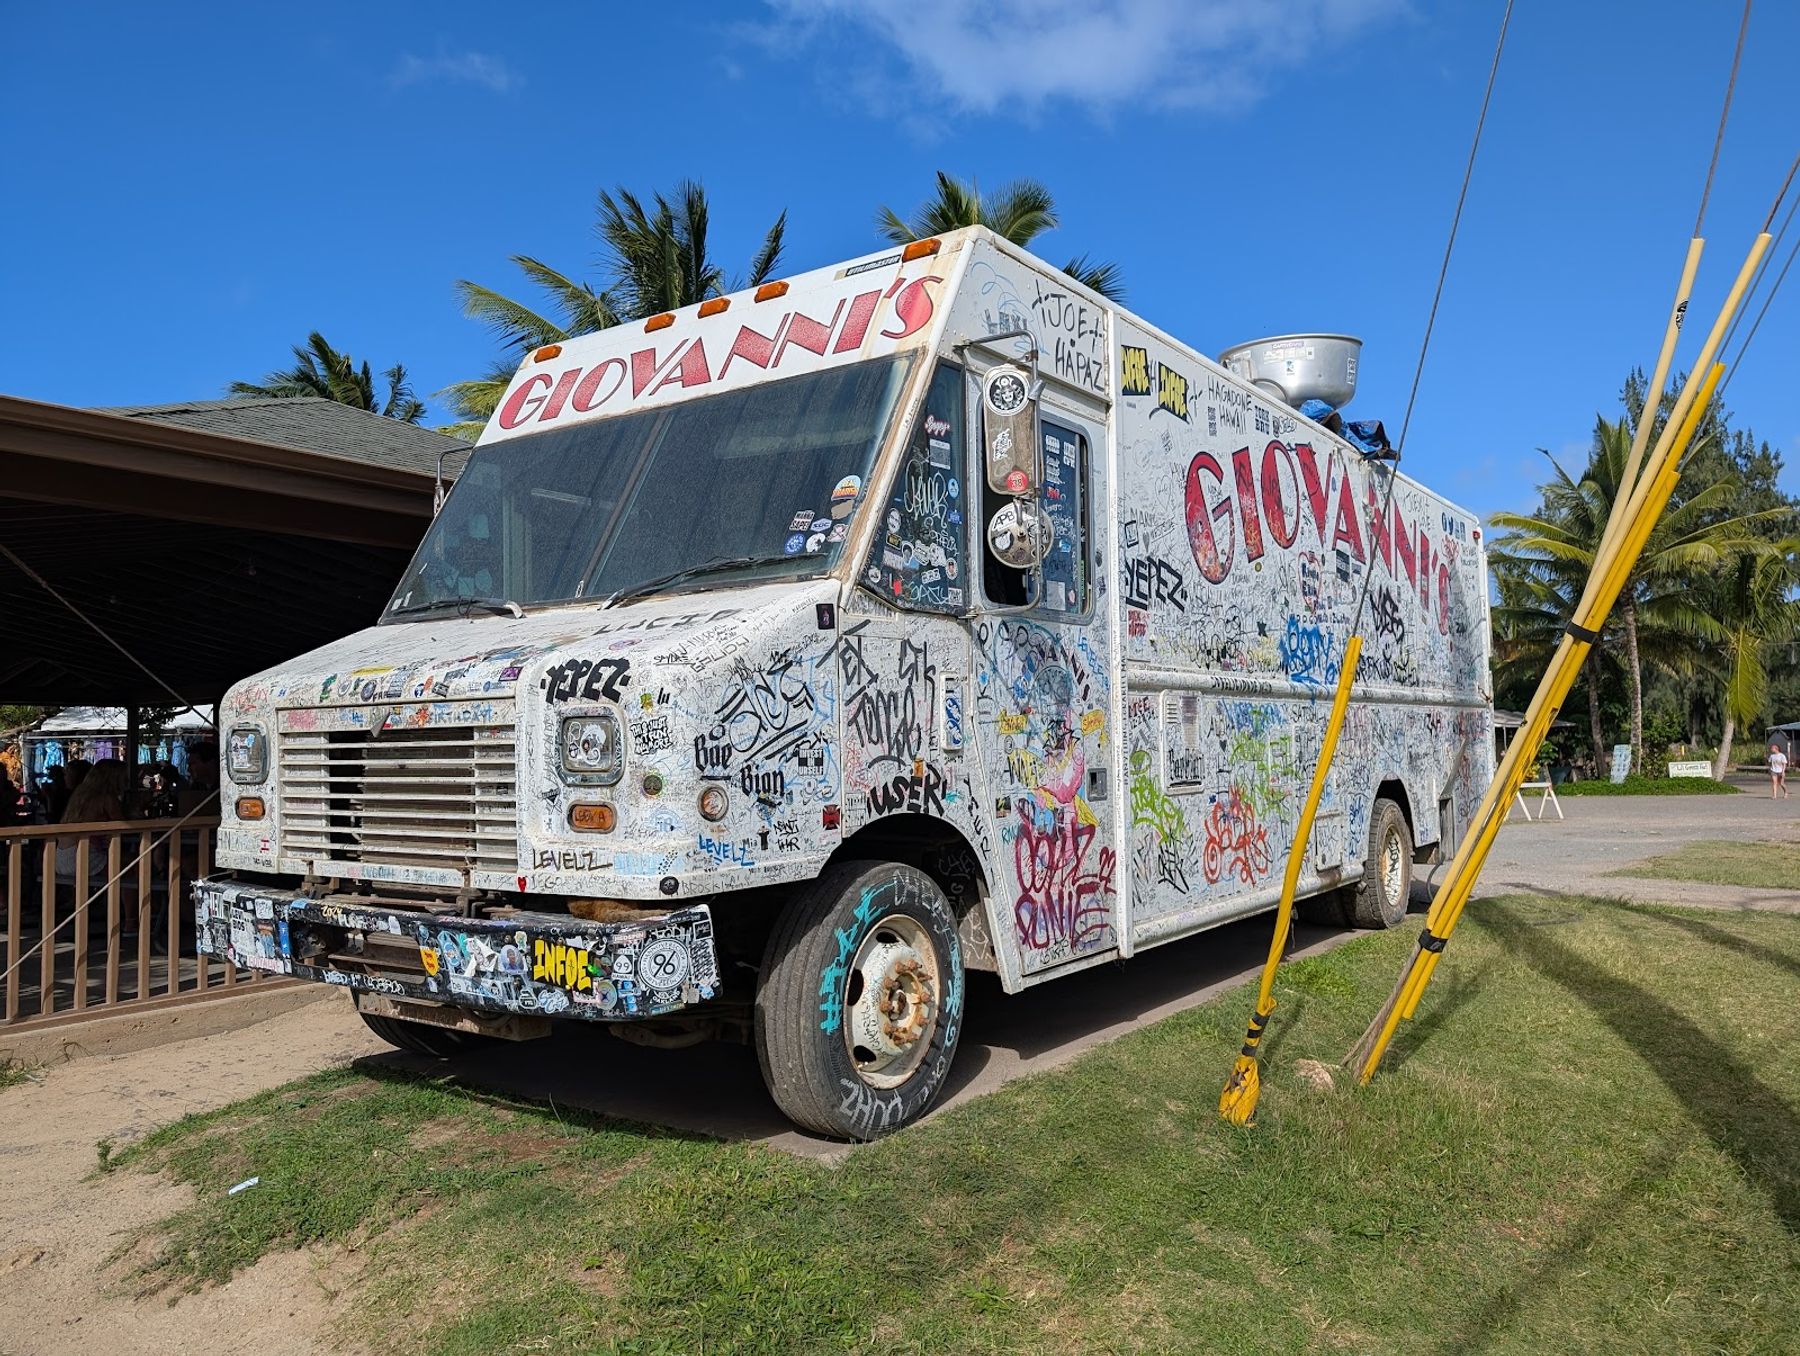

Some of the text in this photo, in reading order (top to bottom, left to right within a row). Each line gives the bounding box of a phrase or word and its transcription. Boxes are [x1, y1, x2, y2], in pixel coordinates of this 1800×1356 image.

[499, 276, 943, 431] GIOVANNI'S
[1207, 375, 1252, 411] HAGADONE
[1218, 404, 1247, 435] HAWAII
[993, 510, 1015, 529] APB
[1185, 440, 1449, 636] GIOVANNI'S
[545, 658, 629, 704] YEPEZ
[533, 848, 613, 872] LEVELZ
[699, 833, 755, 866] LEVELZ
[533, 939, 592, 991] INFOE
[615, 962, 630, 971] 99
[653, 951, 676, 978] 96
[652, 990, 680, 1004] OAKLAND
